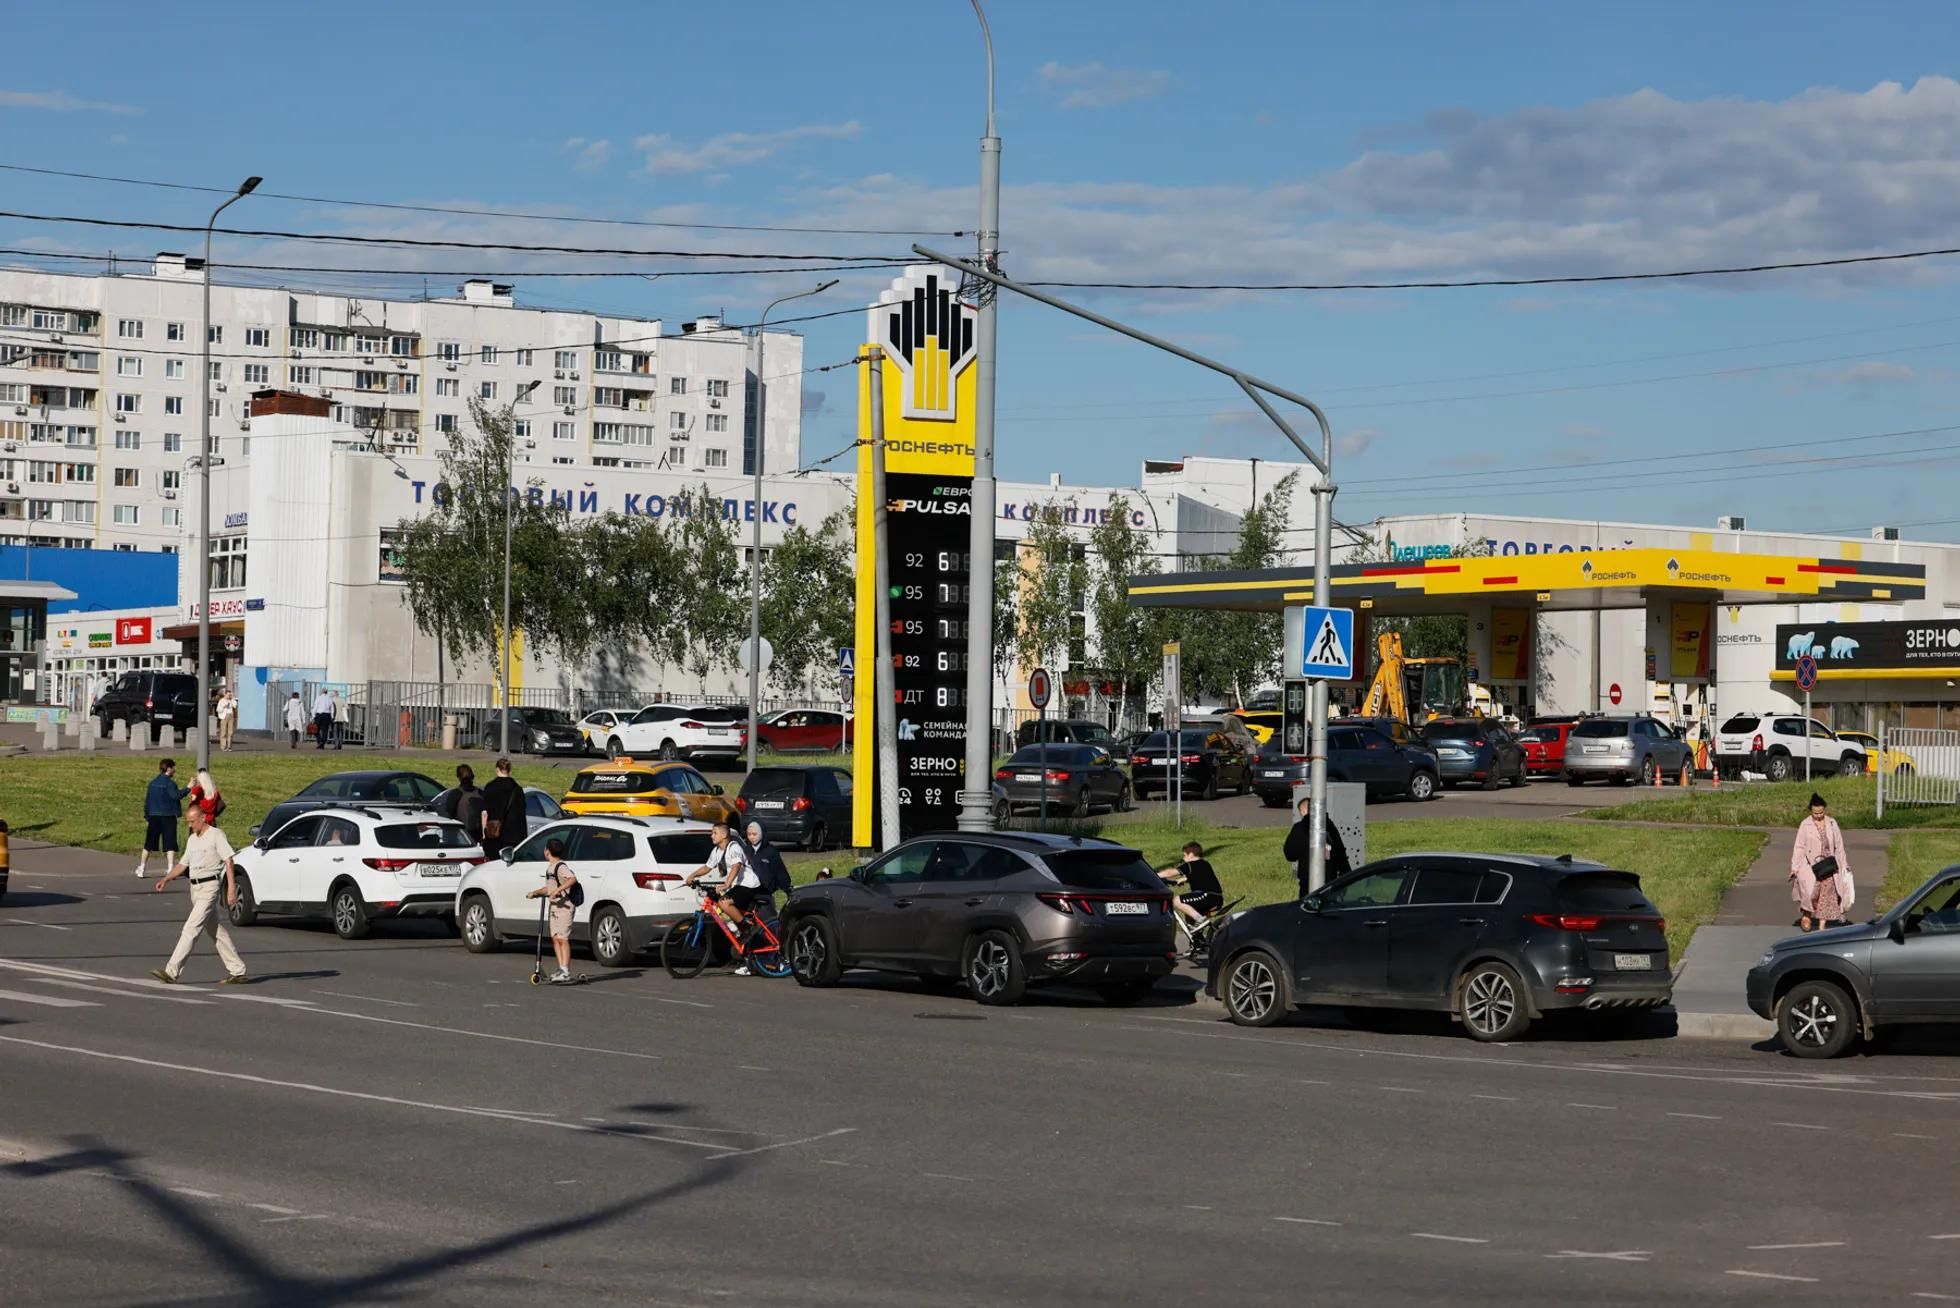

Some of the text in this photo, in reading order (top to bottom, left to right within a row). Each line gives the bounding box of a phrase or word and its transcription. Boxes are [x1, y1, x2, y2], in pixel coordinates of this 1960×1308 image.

[886, 440, 975, 456] ОСНЕФТЬ
[411, 481, 797, 525] ТООВЫЙ КОМЛЕКС
[901, 500, 971, 515] PULSA
[1003, 503, 1145, 526] КОМПЛЕС
[906, 553, 923, 568] 92
[1592, 571, 1637, 580] РОСНЕФТЬ
[1680, 571, 1732, 582] РОСНЕФТЬ
[905, 585, 923, 600] 95
[905, 620, 923, 635] 95
[1717, 635, 1762, 643] ОСНЕФТЬ
[905, 655, 920, 667] 92
[904, 690, 925, 704] ДТ
[923, 731, 967, 739] КОМАНДА
[910, 757, 957, 770] ЗЕРНО
[899, 797, 912, 805] 24
